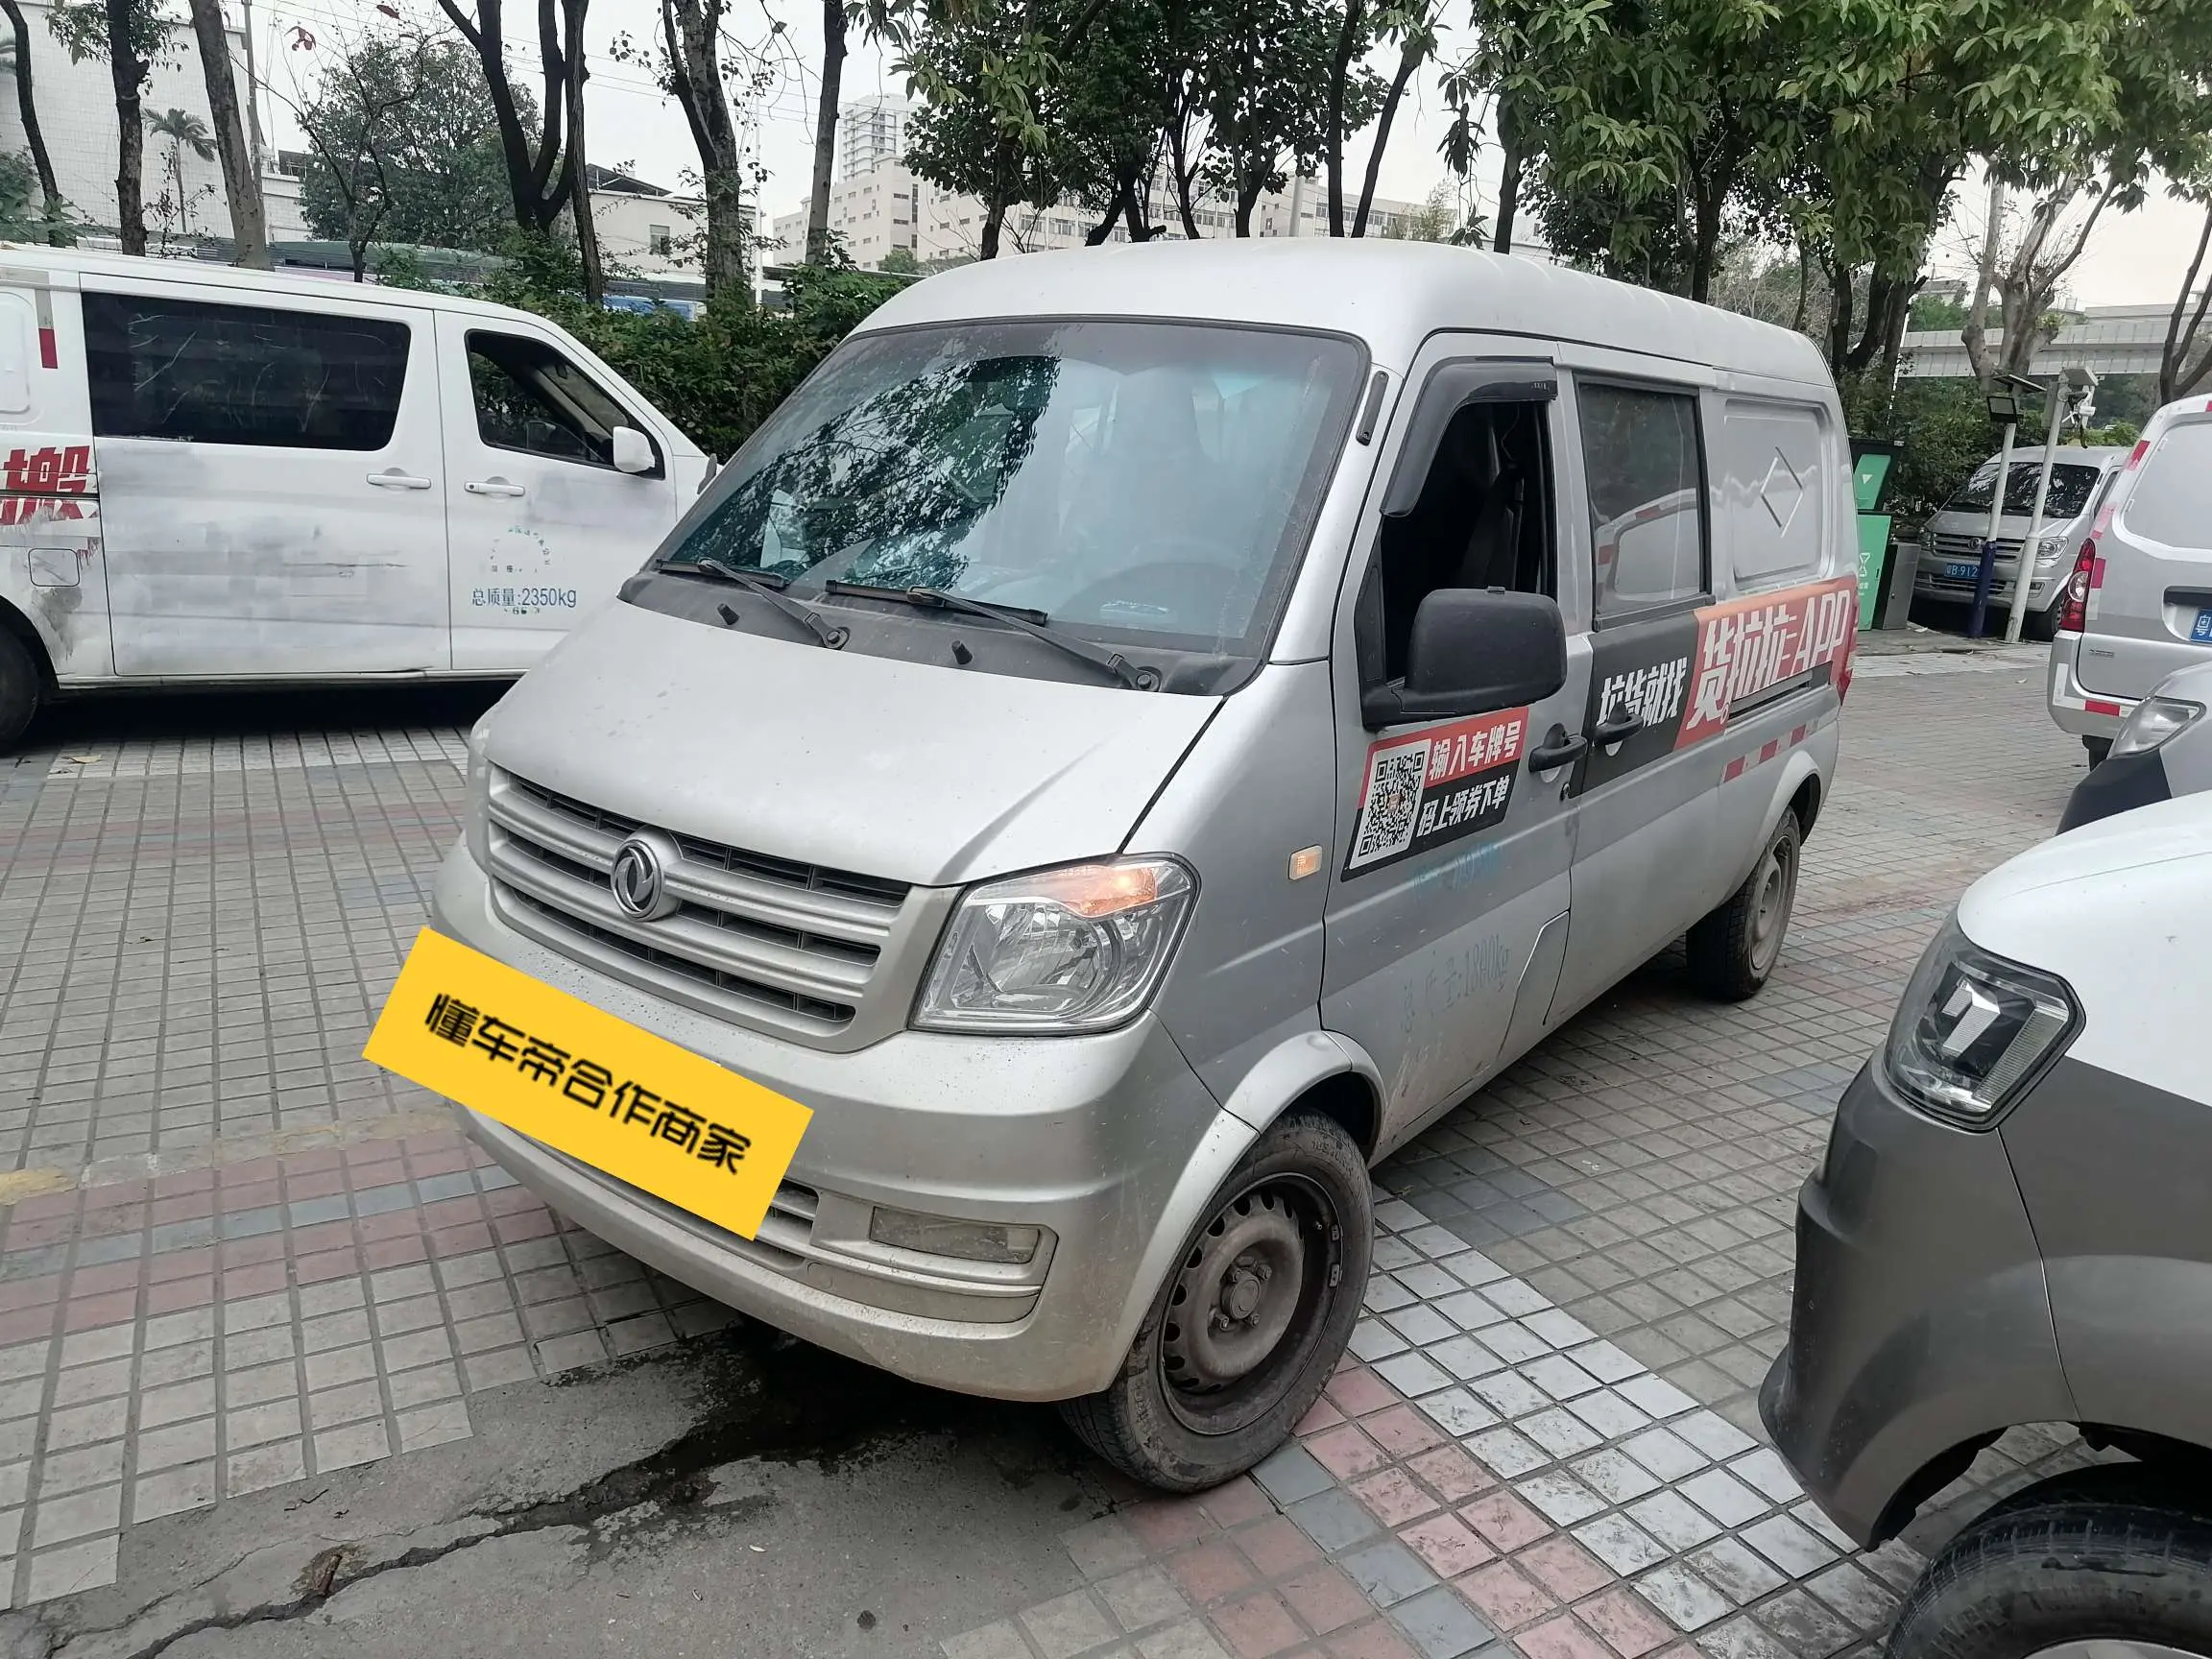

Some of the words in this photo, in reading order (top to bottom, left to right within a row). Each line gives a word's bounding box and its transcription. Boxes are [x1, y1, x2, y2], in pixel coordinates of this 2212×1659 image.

[471, 587, 577, 608] 总质量:2350kg
[1597, 657, 1687, 727] 拉货就找
[1687, 589, 1850, 731] 货拉拉APP
[1429, 720, 1521, 781] 输入车牌号
[1416, 775, 1509, 837] 码上领券下单
